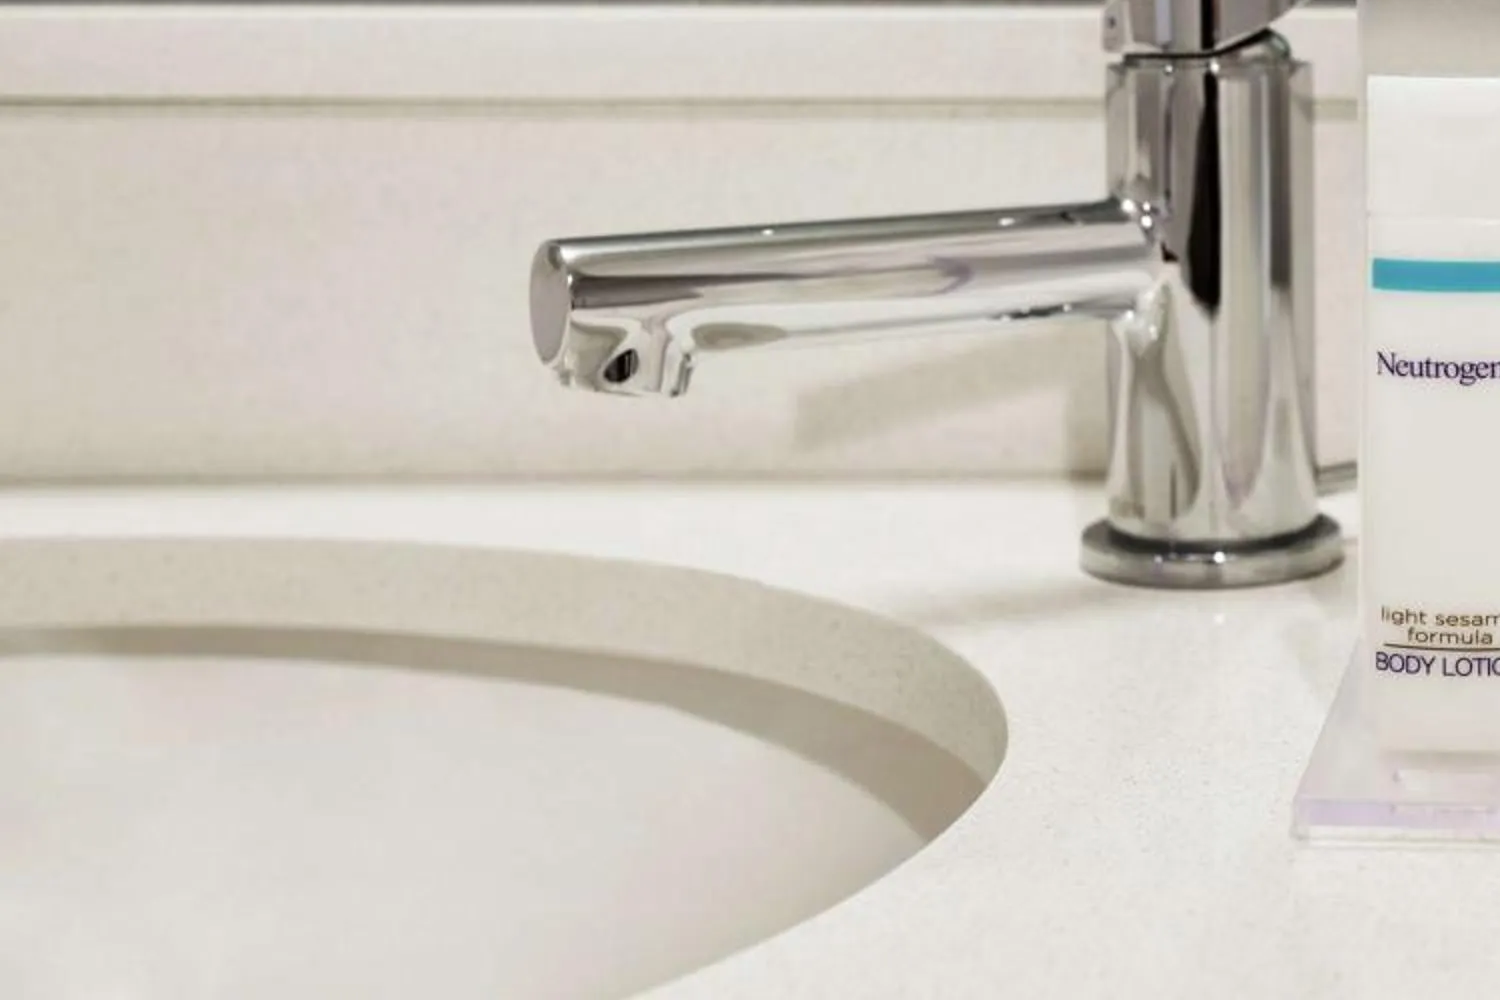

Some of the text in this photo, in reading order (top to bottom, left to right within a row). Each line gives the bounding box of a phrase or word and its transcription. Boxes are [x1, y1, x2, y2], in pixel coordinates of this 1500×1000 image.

[1380, 606, 1428, 626] light
[1407, 626, 1494, 645] formula
[1375, 651, 1436, 676] BODY
